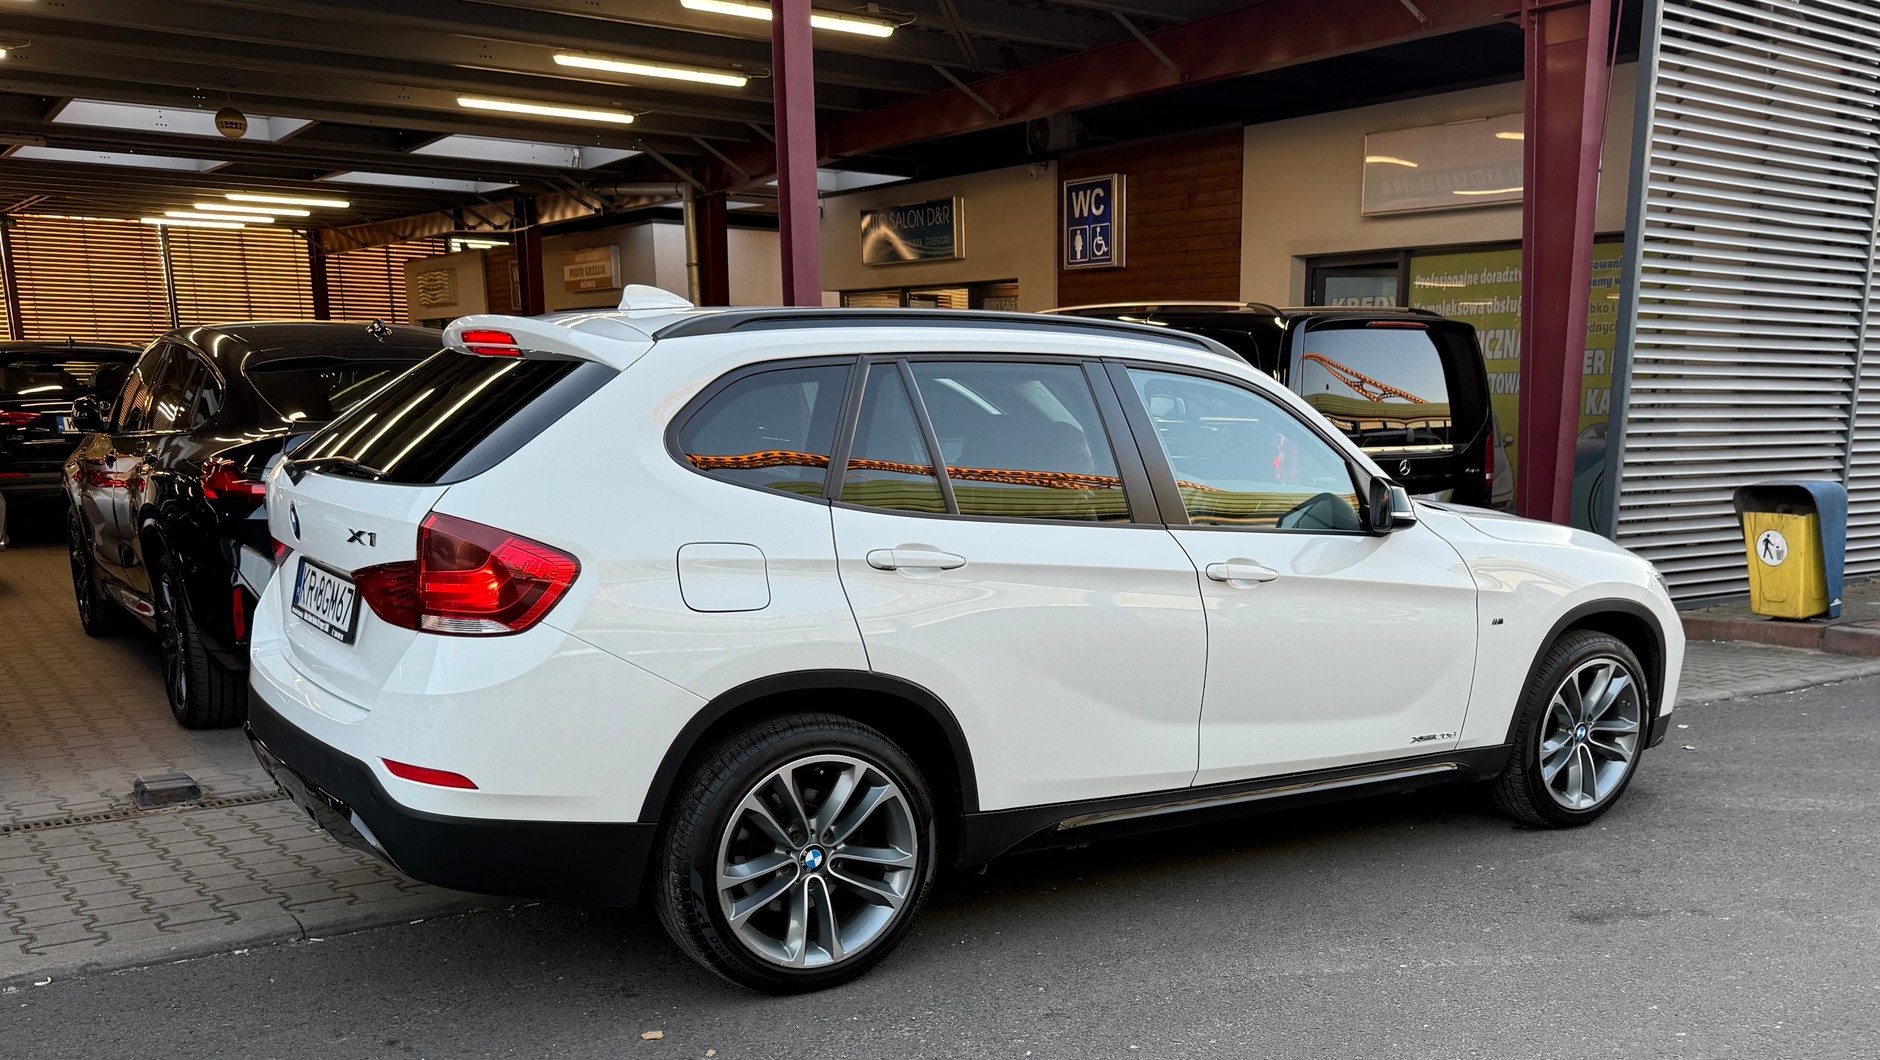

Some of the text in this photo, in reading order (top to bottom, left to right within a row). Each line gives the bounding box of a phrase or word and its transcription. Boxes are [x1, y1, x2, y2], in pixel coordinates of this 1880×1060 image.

[1071, 187, 1105, 219] WC
[889, 208, 924, 230] SALON
[926, 205, 950, 226] D&R
[1415, 269, 1479, 291] Profesjonalne
[346, 527, 377, 548] X1
[301, 566, 317, 609] KR
[316, 575, 355, 626] 8GM67
